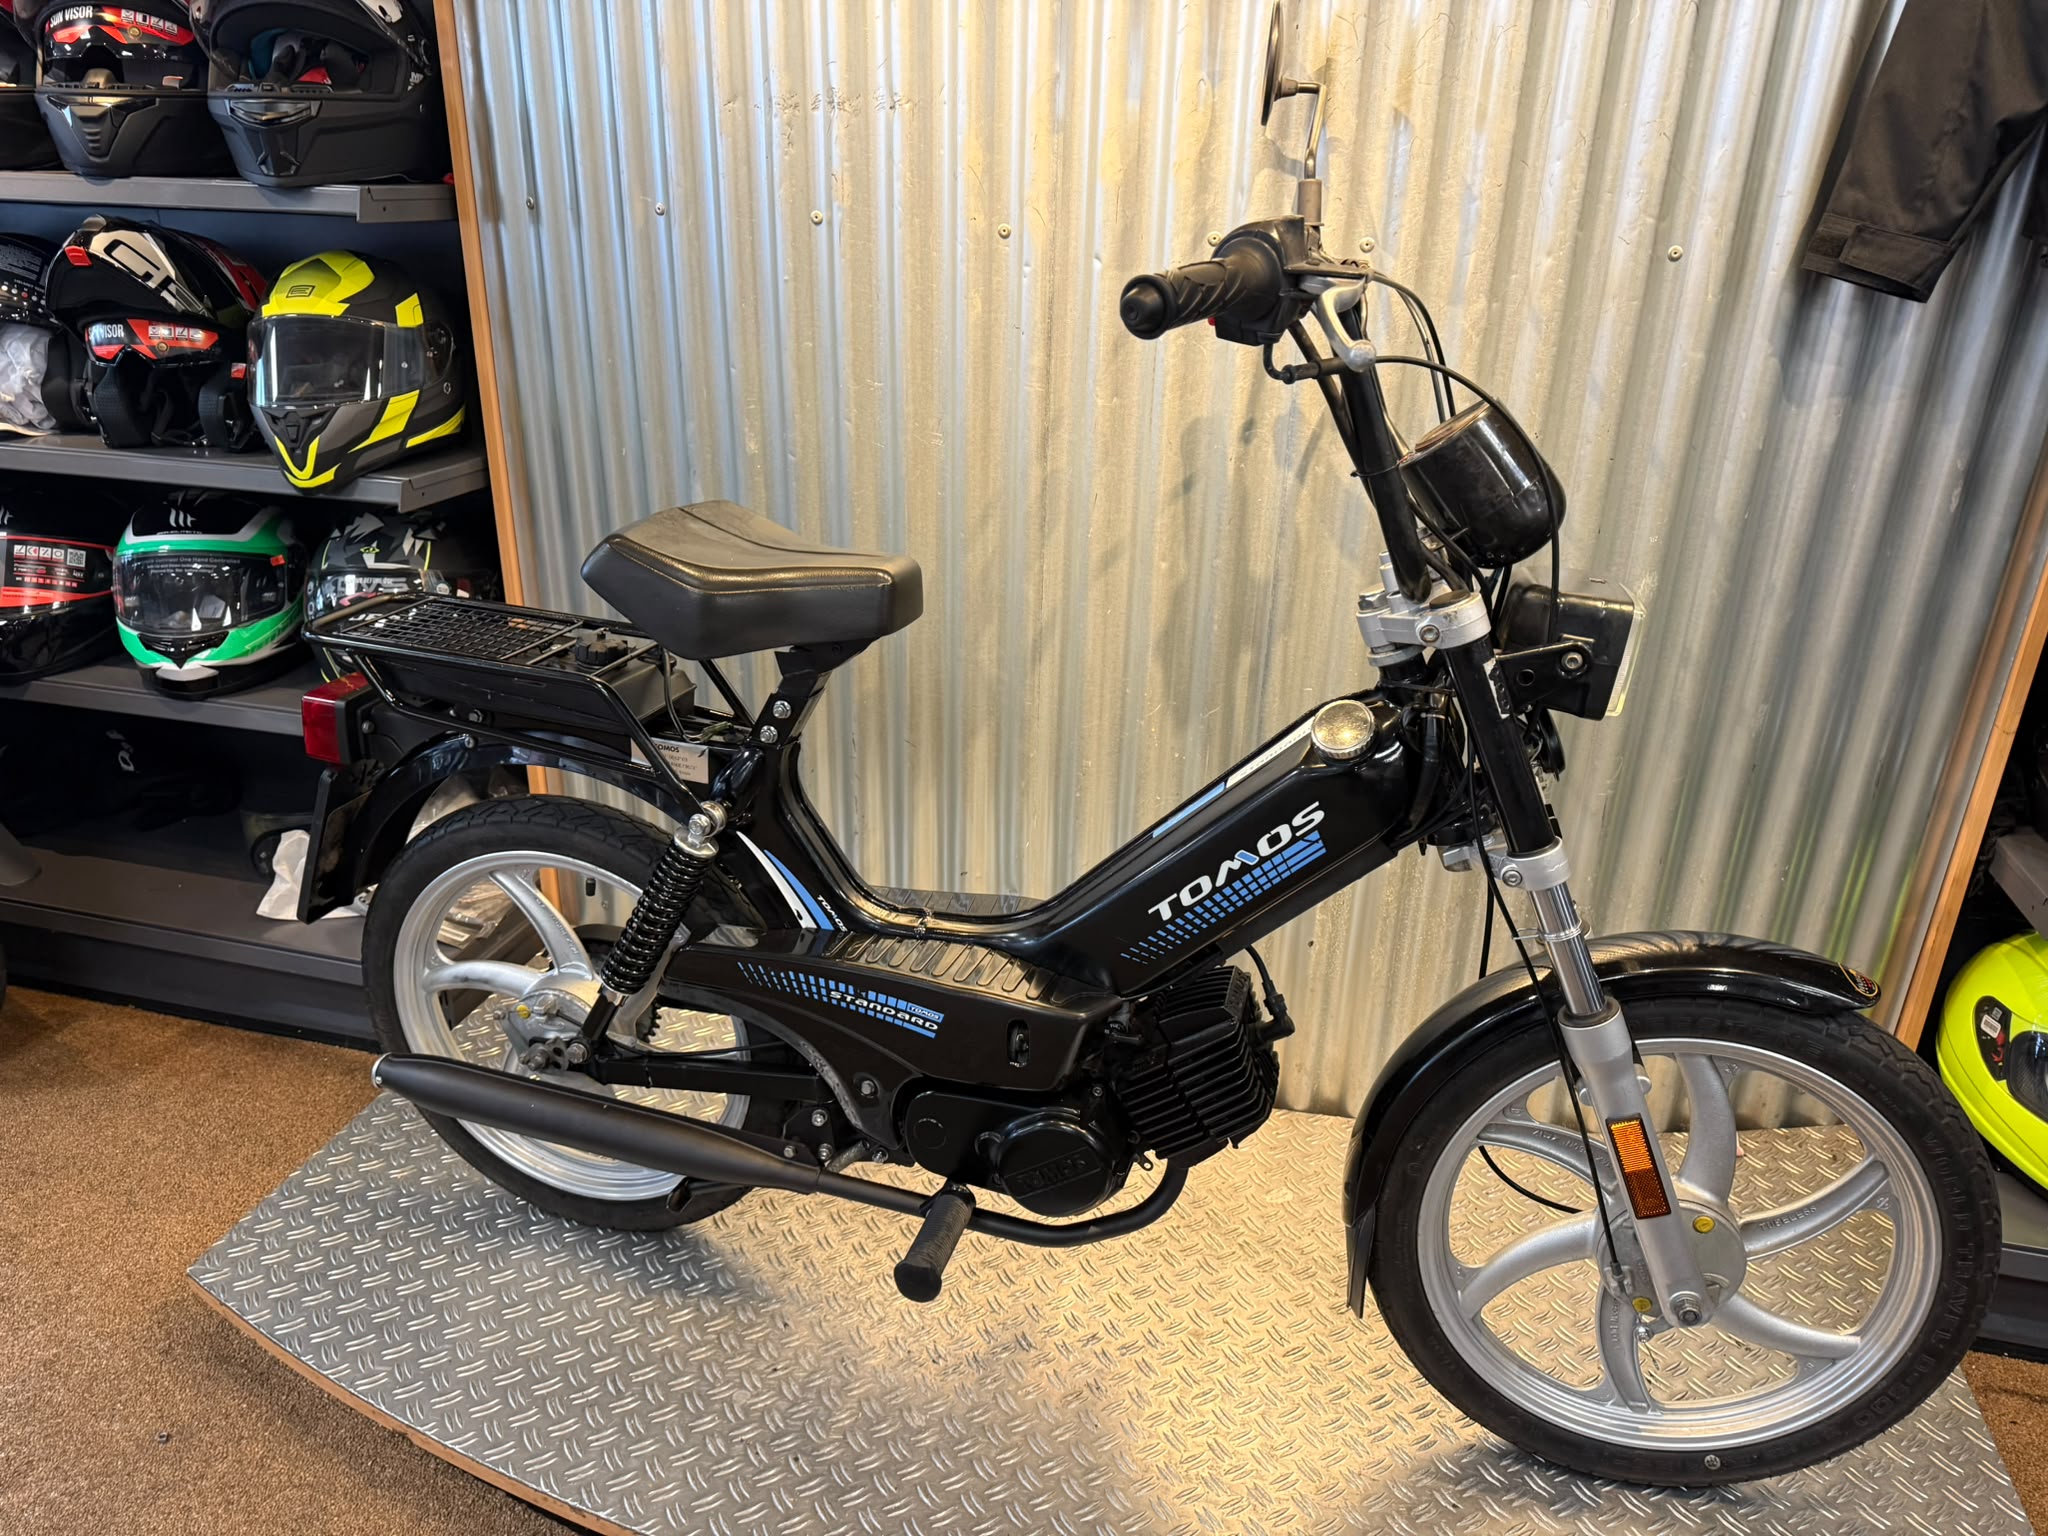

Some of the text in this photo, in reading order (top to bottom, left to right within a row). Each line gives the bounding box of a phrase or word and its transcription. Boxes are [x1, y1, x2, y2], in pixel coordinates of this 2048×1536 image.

[50, 5, 93, 28] SUN VISOR
[1148, 801, 1325, 921] TOMOS
[817, 895, 848, 932] TOMOS
[910, 1006, 940, 1020] TOMOS
[1759, 1206, 1817, 1230] TUBELESS
